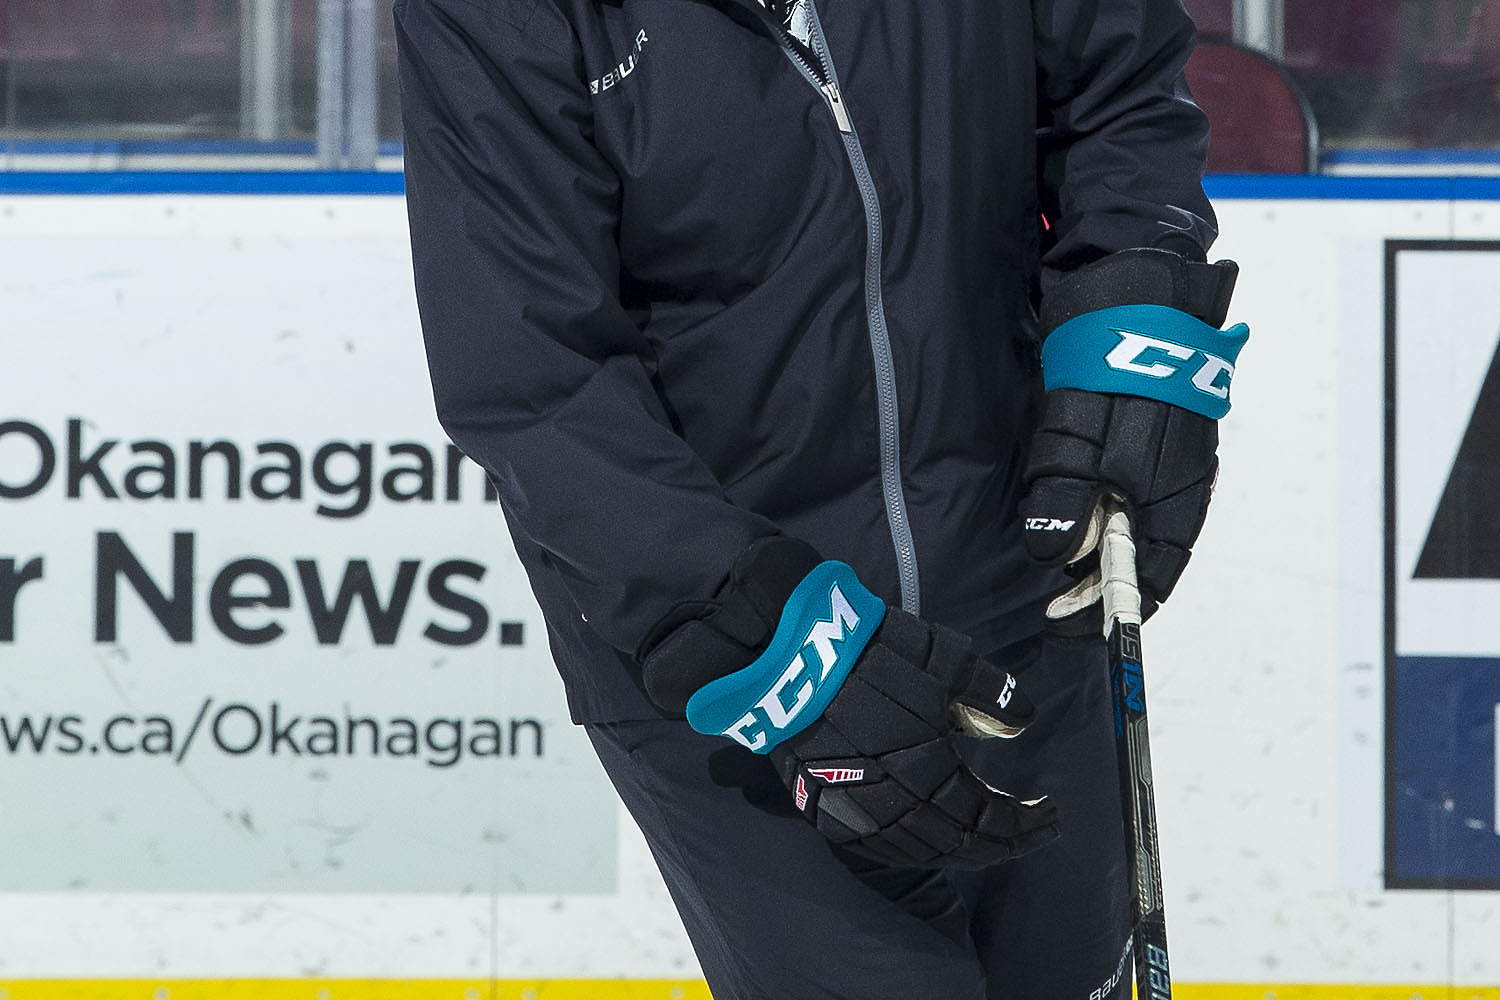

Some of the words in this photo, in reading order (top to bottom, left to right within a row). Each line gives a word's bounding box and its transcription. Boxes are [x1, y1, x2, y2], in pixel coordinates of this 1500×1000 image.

[0, 418, 499, 519] Okanagan
[94, 530, 525, 647] News.
[721, 581, 862, 753] CCM
